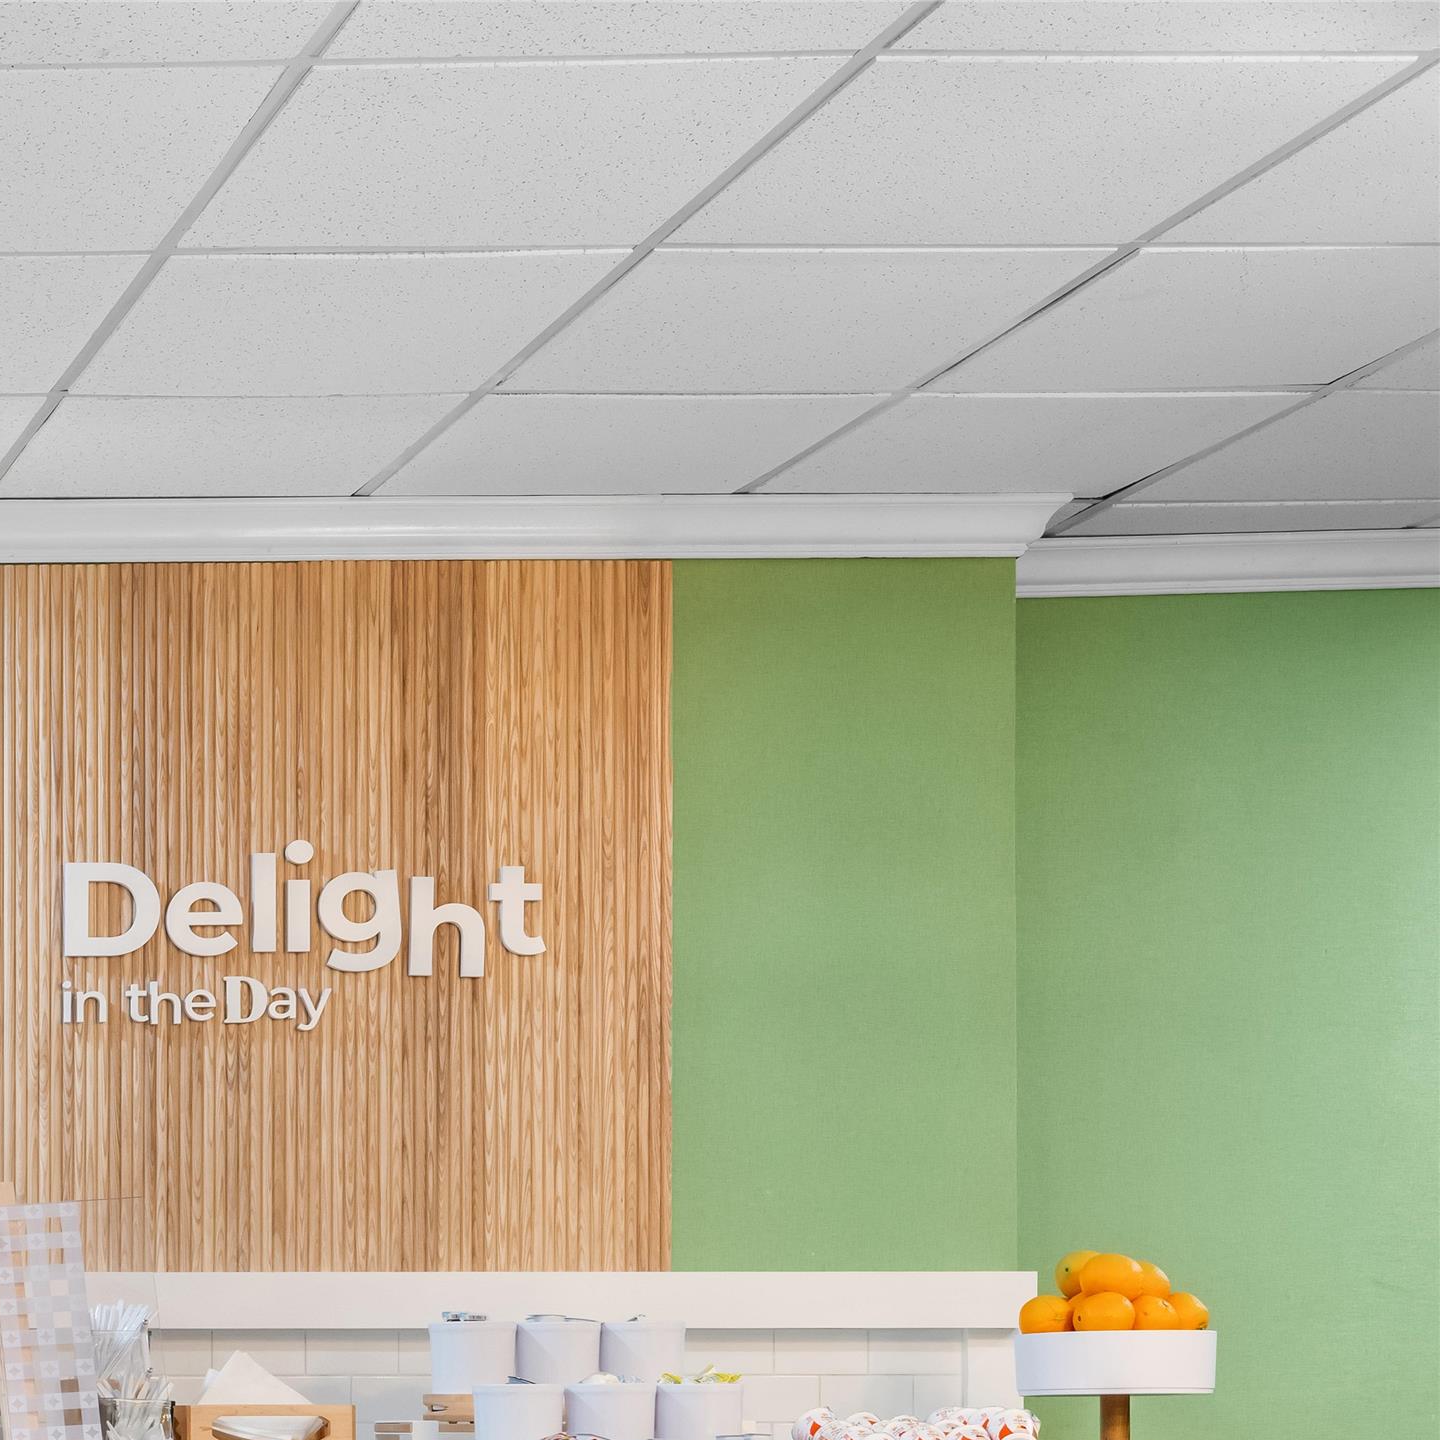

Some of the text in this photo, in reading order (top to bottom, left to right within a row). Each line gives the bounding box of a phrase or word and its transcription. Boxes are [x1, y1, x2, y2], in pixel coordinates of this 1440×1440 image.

[63, 839, 548, 978] Delight
[61, 976, 333, 1032] in the Day
